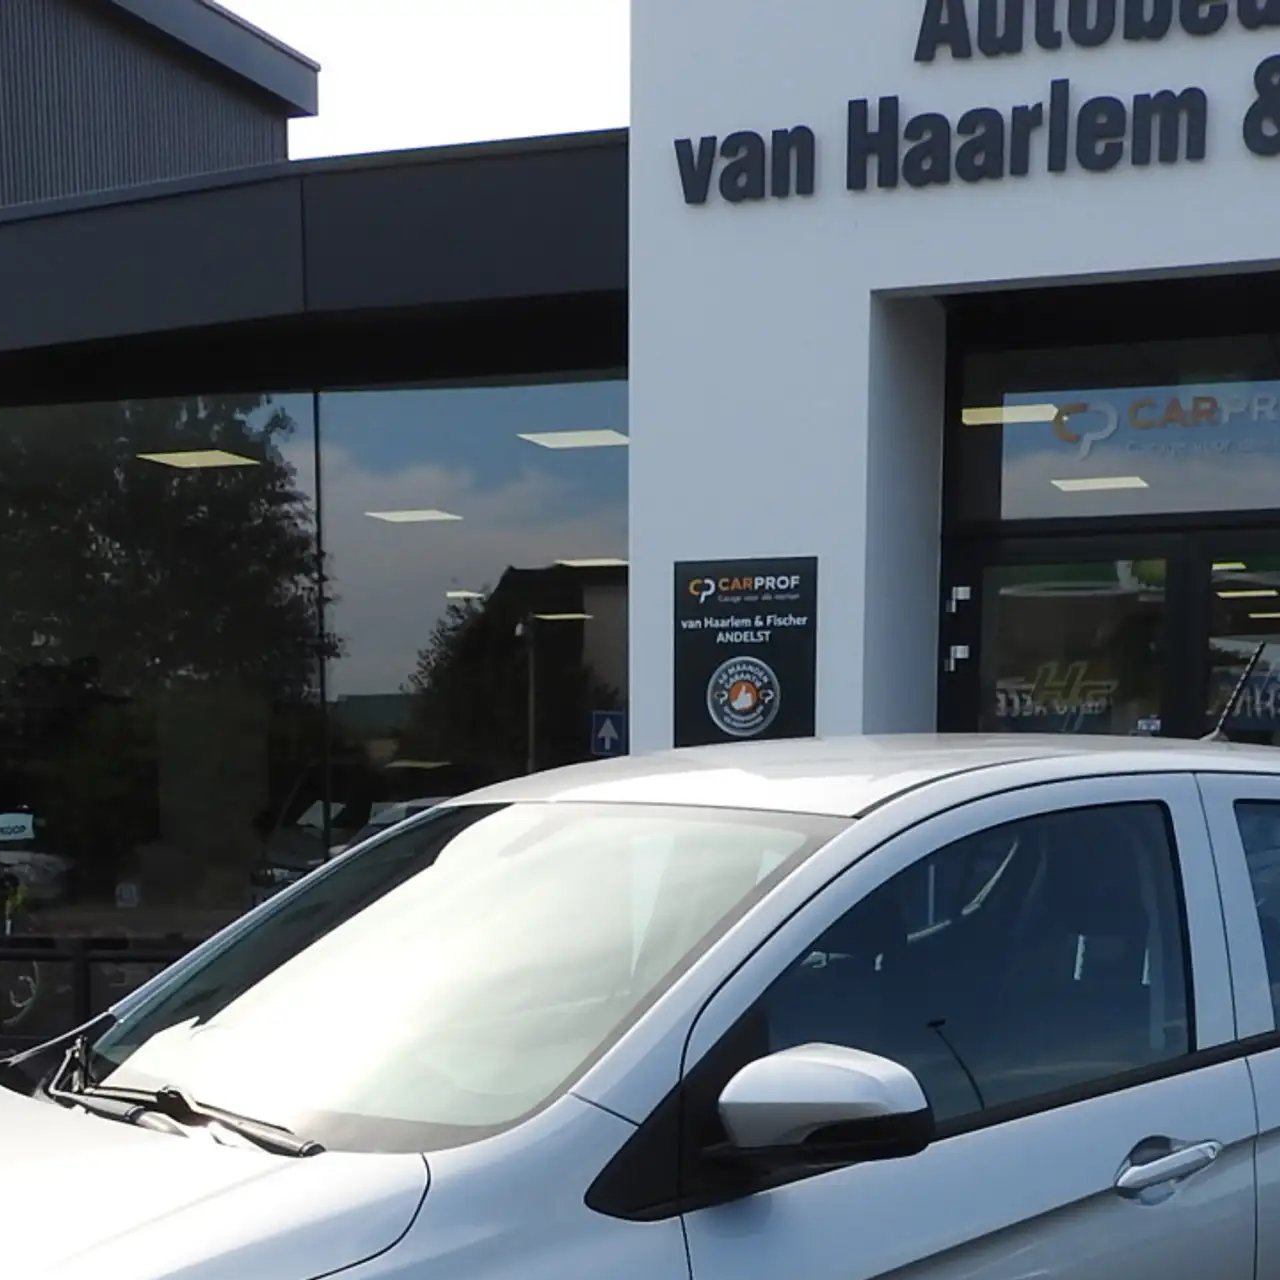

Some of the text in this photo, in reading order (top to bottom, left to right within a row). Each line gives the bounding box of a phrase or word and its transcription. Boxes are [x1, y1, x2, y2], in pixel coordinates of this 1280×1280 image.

[674, 125, 816, 205] van
[846, 78, 1207, 190] Haarlem
[718, 575, 800, 593] CARPROF
[681, 613, 808, 629] van Haarlem & Fischer
[716, 631, 772, 644] ANDELST
